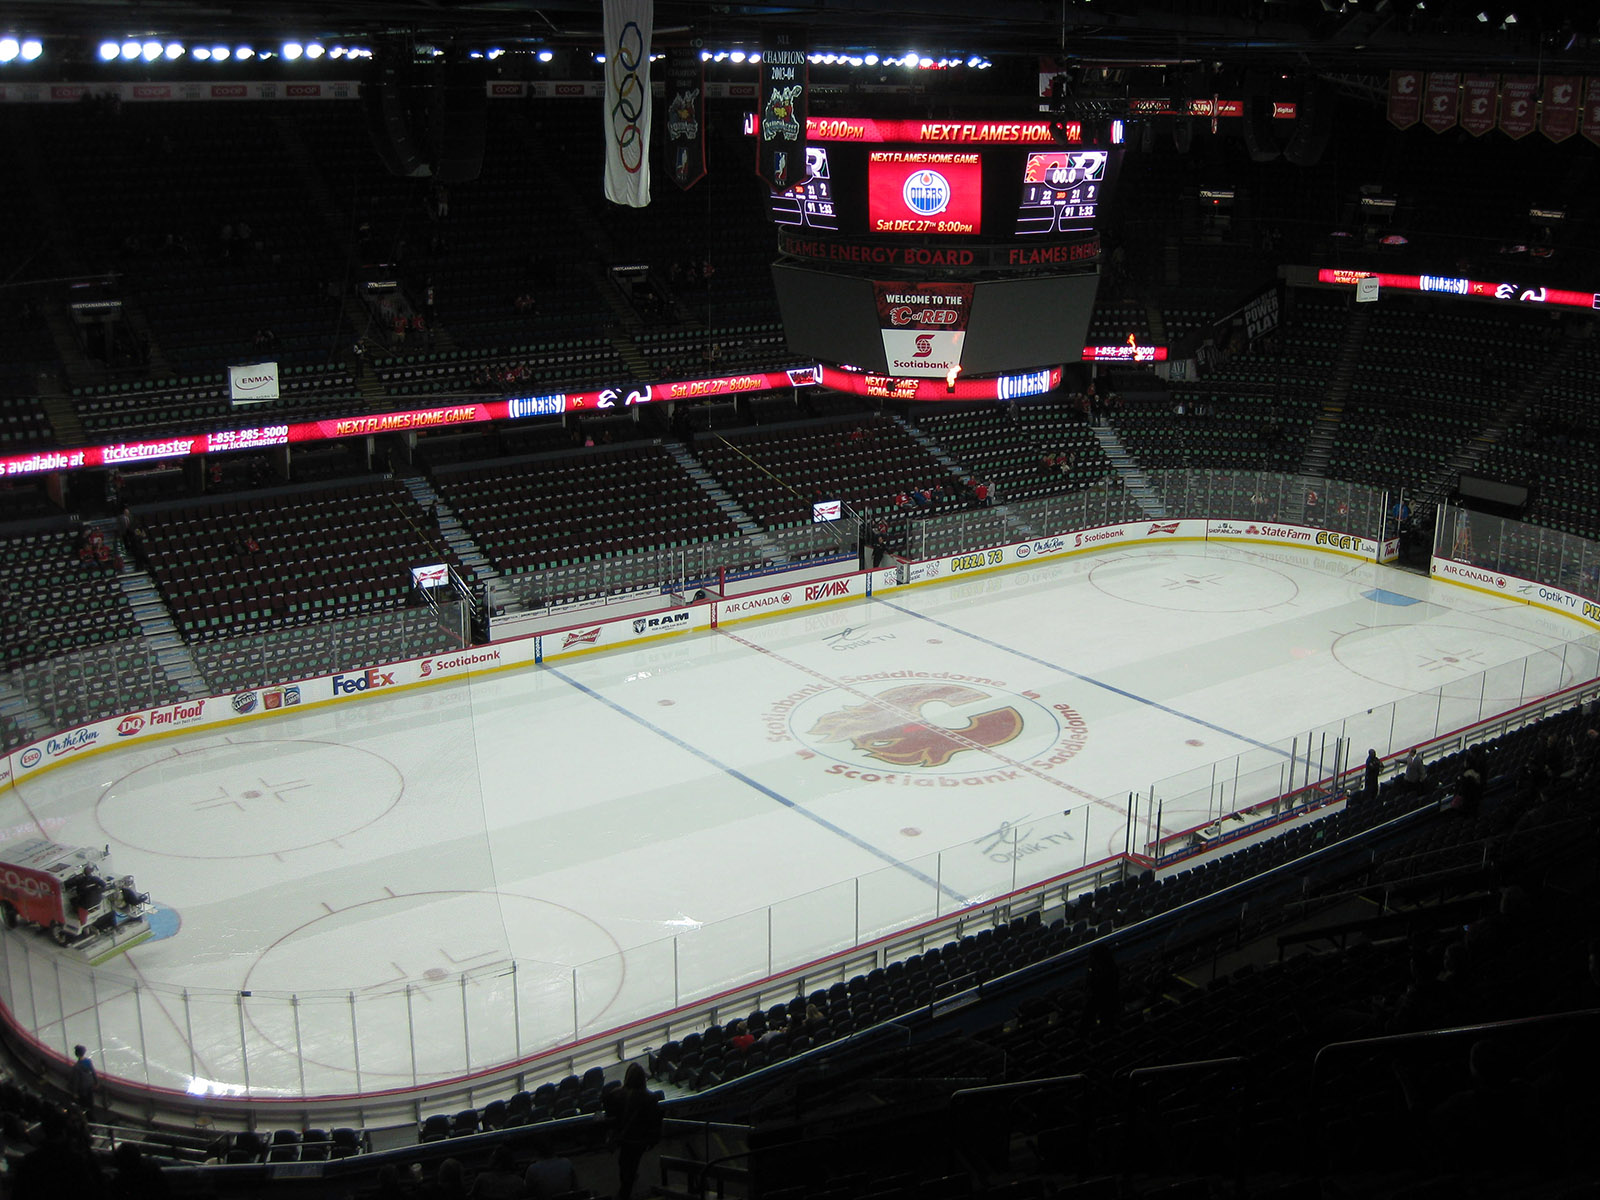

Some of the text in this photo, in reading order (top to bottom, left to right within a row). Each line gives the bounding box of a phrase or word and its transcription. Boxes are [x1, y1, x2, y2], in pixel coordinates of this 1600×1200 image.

[762, 50, 805, 65] CHAMPIONS
[290, 87, 317, 97] CO-OP
[496, 85, 518, 95] CO-OP
[559, 85, 583, 95] CO-OP
[819, 121, 864, 139] 8:00PM
[920, 124, 960, 141] NEXT
[961, 125, 1021, 141] FLAMES
[870, 153, 979, 164] NEXT FLAMES HOME GAME
[1052, 169, 1077, 184] 00.0
[910, 187, 943, 208] OILERS
[1030, 187, 1036, 201] 1
[1042, 190, 1052, 200] 22
[1072, 189, 1081, 199] 21
[1087, 185, 1095, 199] 2
[1065, 206, 1074, 217] 91
[876, 219, 894, 231] Sat
[894, 220, 916, 231] DEC
[937, 221, 973, 232] 8:00PM
[830, 244, 899, 264] ENERGY
[904, 249, 974, 266] BOARD
[1009, 247, 1067, 265] FLAMES
[886, 294, 963, 305] WELCOME TO THE
[911, 312, 922, 321] of
[920, 309, 958, 325] RED
[1244, 295, 1279, 326] POWER
[1246, 309, 1280, 340] PLAY
[893, 359, 949, 369] Scotiabank
[242, 374, 275, 385] ENMAX
[670, 384, 688, 398] Sat,
[690, 381, 710, 396] DEC
[729, 377, 761, 391] 8:00PM
[865, 375, 885, 386] NEXT
[572, 396, 585, 408] VS.
[336, 407, 476, 435] NEXT FLAMES HOME GAME
[207, 425, 289, 444] 1-855-985-5000
[207, 436, 289, 453] www.ticketmaster.ca
[8, 453, 69, 474] available
[70, 451, 85, 466] at
[103, 439, 195, 460] ticketmaster
[1084, 529, 1124, 544] Scotiabank
[1315, 531, 1361, 551] AGAT
[1033, 537, 1065, 553] On the Run
[1361, 543, 1376, 553] Labs
[951, 549, 1004, 573] PIZZA 73
[1443, 564, 1458, 575] AIR
[1459, 567, 1495, 585] CANADA
[805, 579, 850, 602] RE/MAX
[1538, 587, 1577, 608] Optik TV
[725, 596, 780, 614] AIR CANADA
[648, 612, 689, 627] RAM
[437, 650, 501, 671] Scotiabank
[332, 668, 395, 696] FedEx
[150, 695, 206, 726] Fan Food
[765, 669, 1008, 744] Scotiabank Saddledome
[122, 718, 142, 733] DQ
[47, 728, 100, 755] On the Run
[824, 702, 1089, 788] Scotiabank Saddledome
[23, 752, 39, 764] Esso
